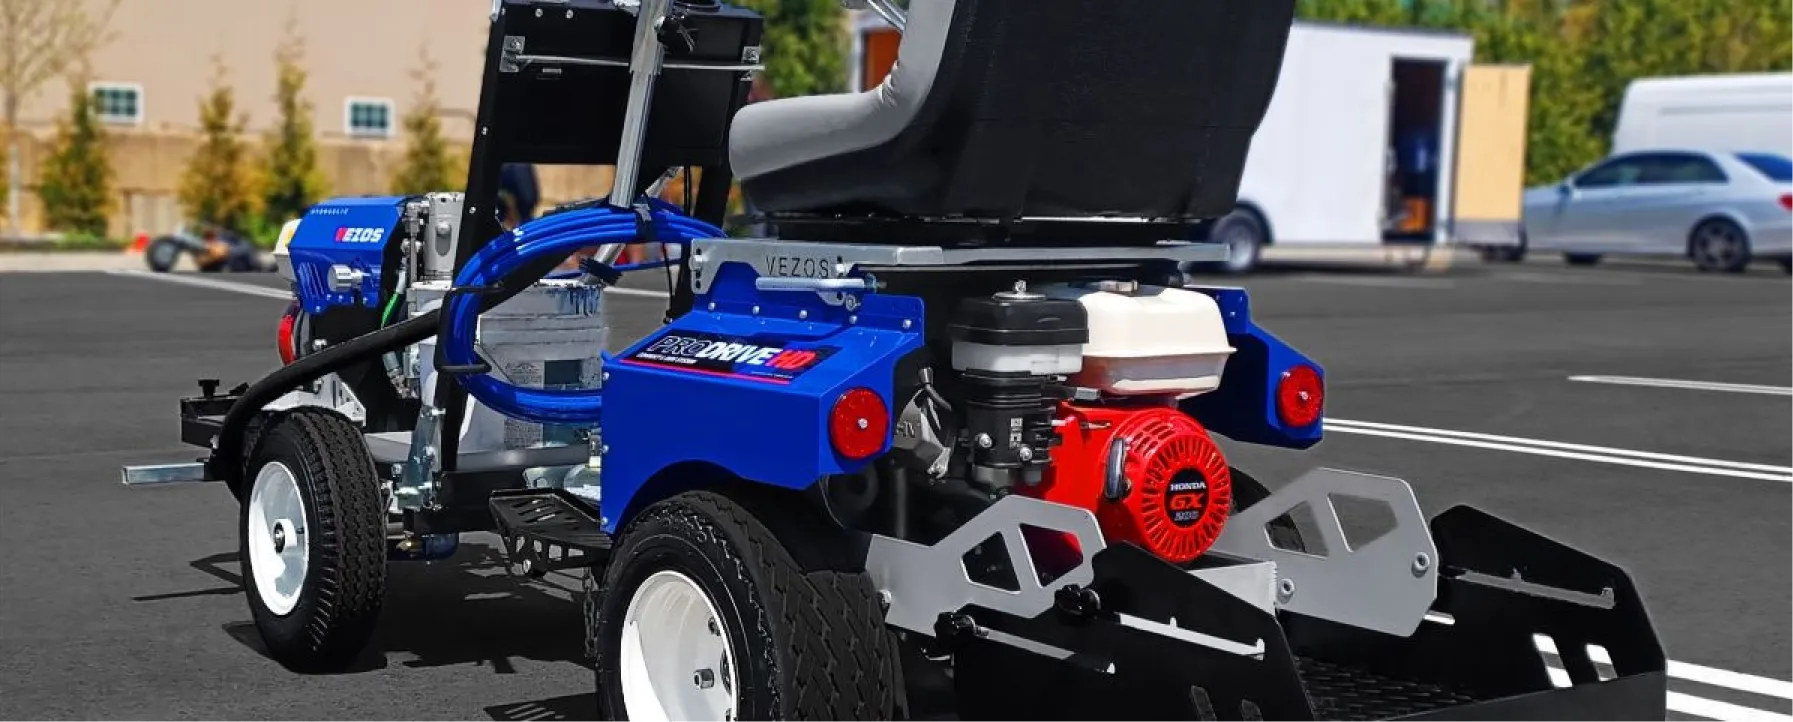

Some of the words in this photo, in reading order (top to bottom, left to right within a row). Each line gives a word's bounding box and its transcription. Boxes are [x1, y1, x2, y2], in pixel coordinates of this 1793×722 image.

[765, 256, 829, 279] VEZOS
[1170, 482, 1206, 491] HONDA
[1171, 494, 1204, 509] GX
